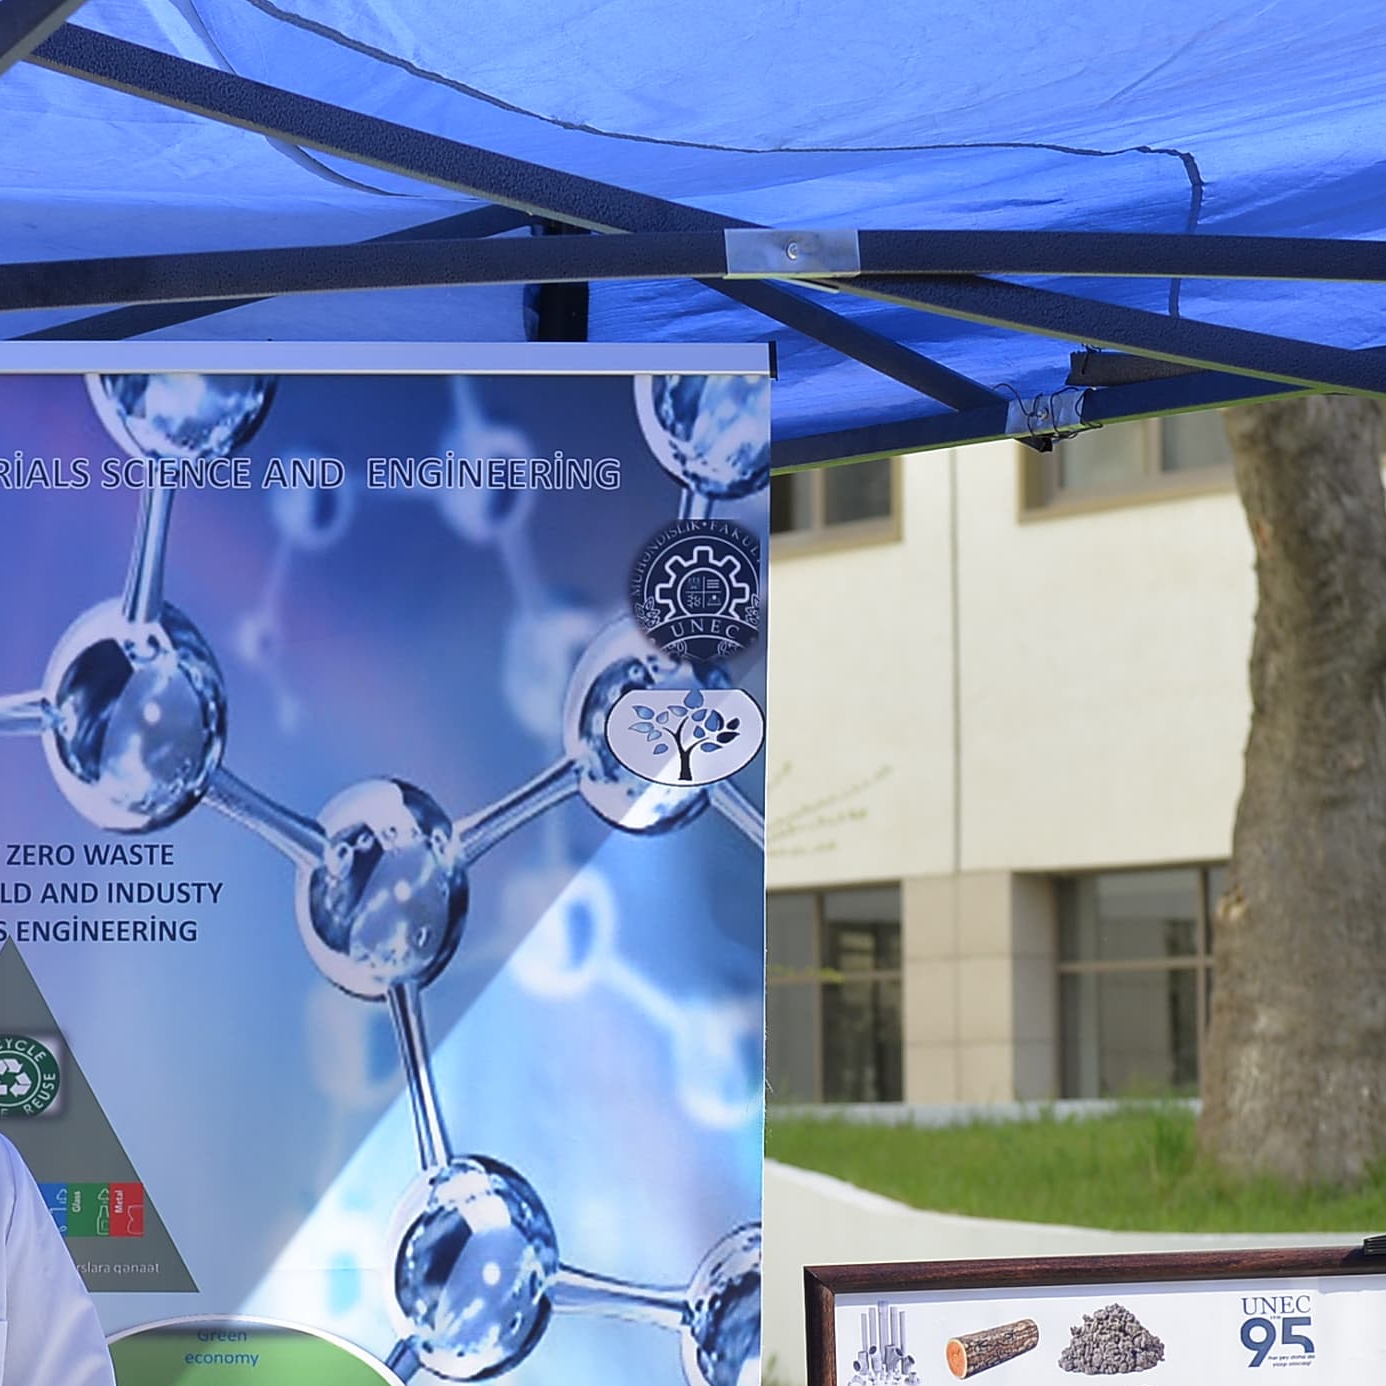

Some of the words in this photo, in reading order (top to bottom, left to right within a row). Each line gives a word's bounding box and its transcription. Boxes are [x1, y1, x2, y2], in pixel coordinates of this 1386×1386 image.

[101, 456, 252, 490] SCIENCE
[261, 457, 345, 490] AND
[366, 450, 622, 491] ENGİNEERİNG
[670, 618, 741, 640] UNEC
[5, 844, 77, 867] ZERO
[83, 844, 174, 867] WASTE
[40, 882, 100, 905] AND
[107, 882, 223, 905] INDUSTY
[17, 915, 198, 943] ENGİNEERİNG
[22, 1072, 57, 1115] REUSE
[72, 1190, 82, 1213] Glass
[114, 1190, 123, 1214] Metal
[1242, 1295, 1312, 1316] UNEC
[197, 1328, 248, 1343] Green
[1240, 1316, 1315, 1368] 95
[184, 1351, 260, 1367] economy
